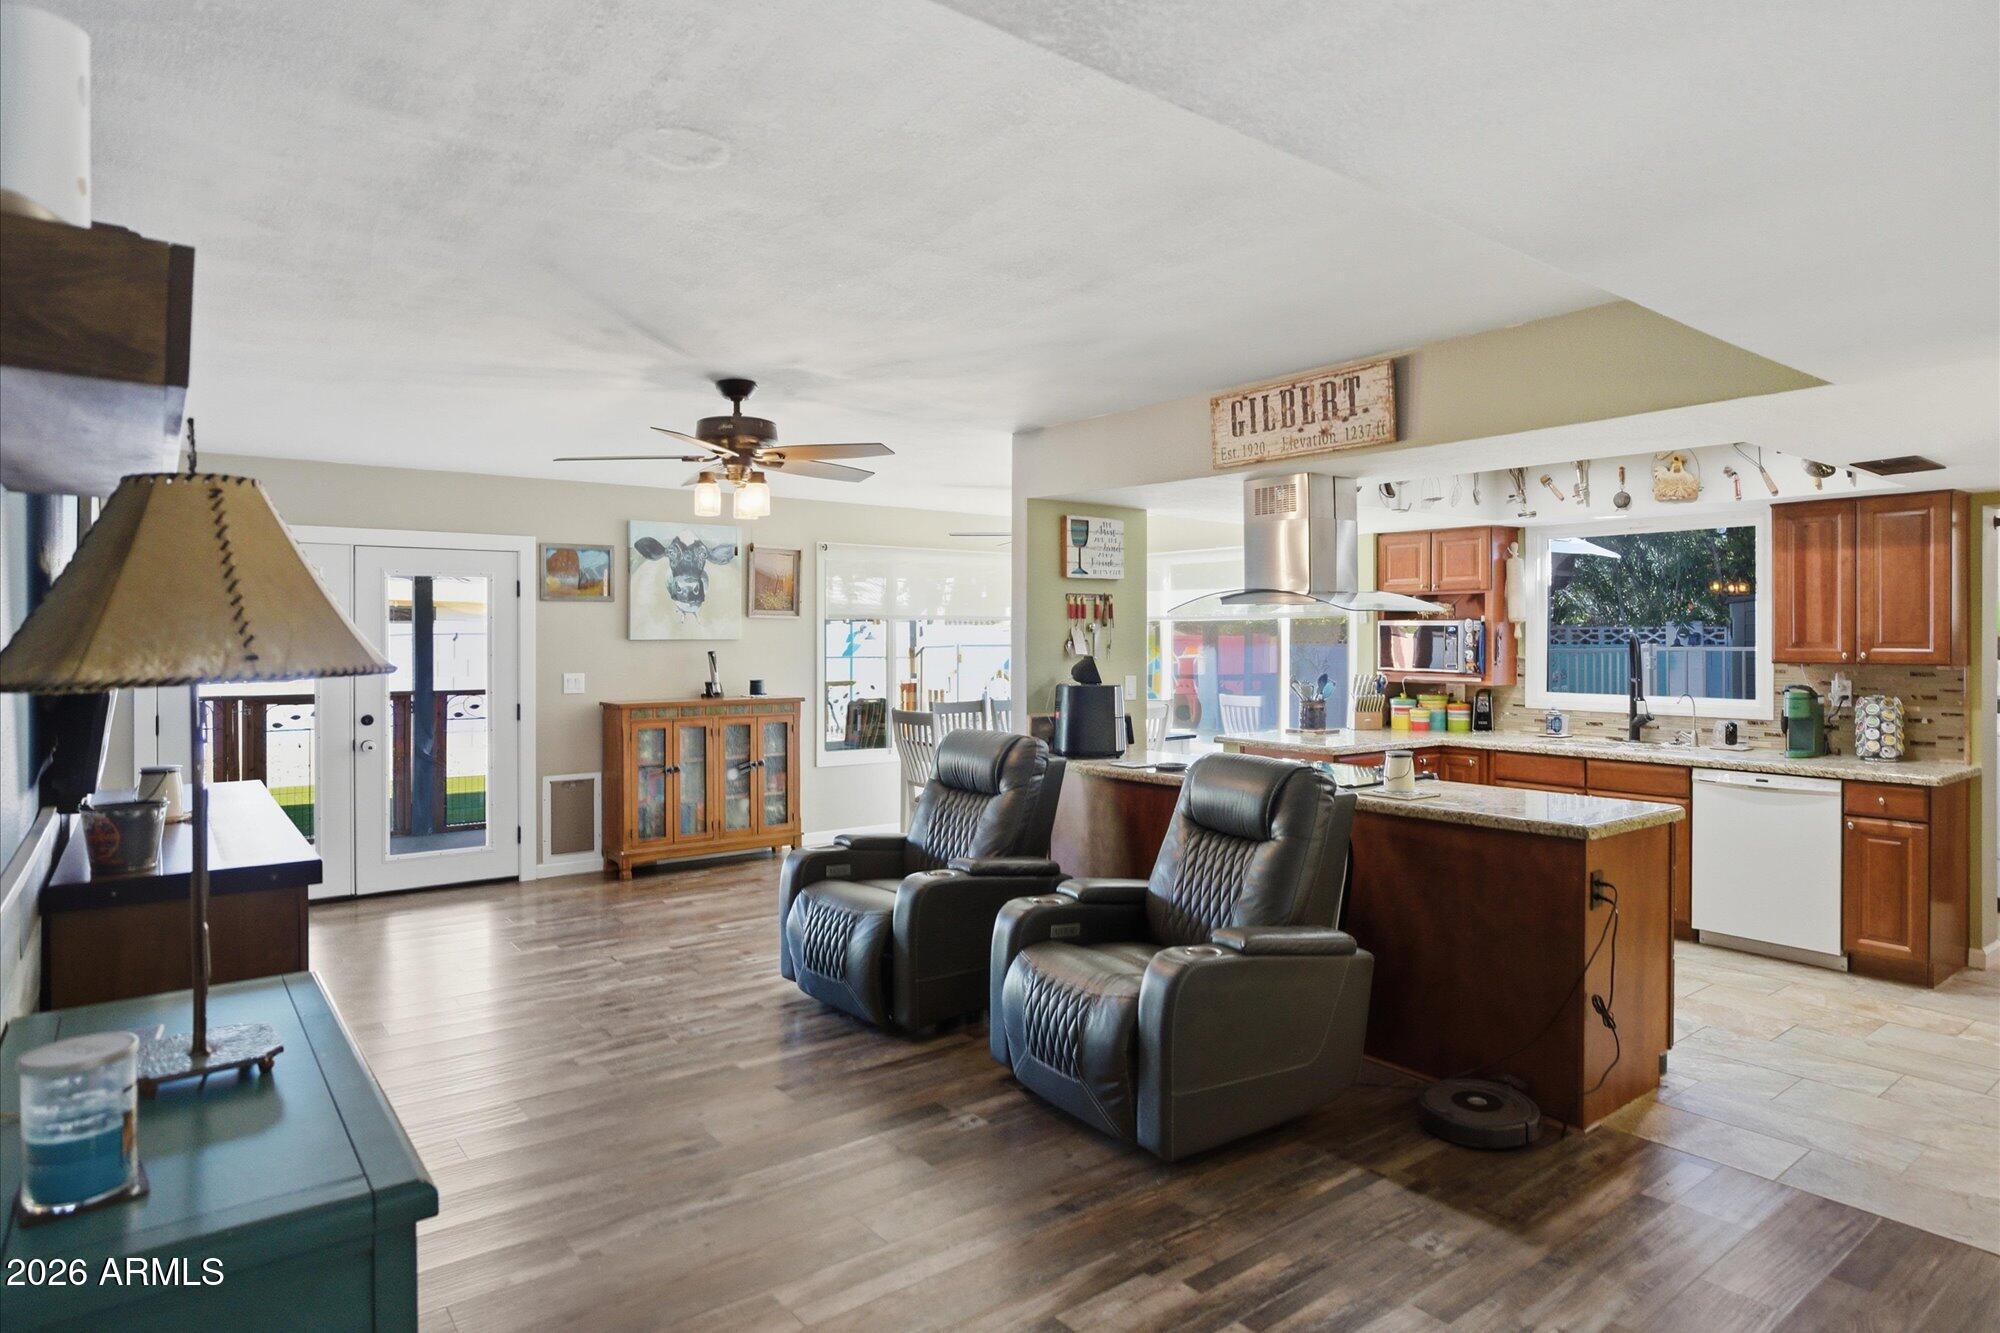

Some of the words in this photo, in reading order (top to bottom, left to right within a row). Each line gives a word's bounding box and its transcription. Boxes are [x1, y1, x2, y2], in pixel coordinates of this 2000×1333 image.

[1220, 446, 1240, 462] Est.
[1281, 431, 1338, 452] Elevation
[1345, 424, 1372, 441] 1237
